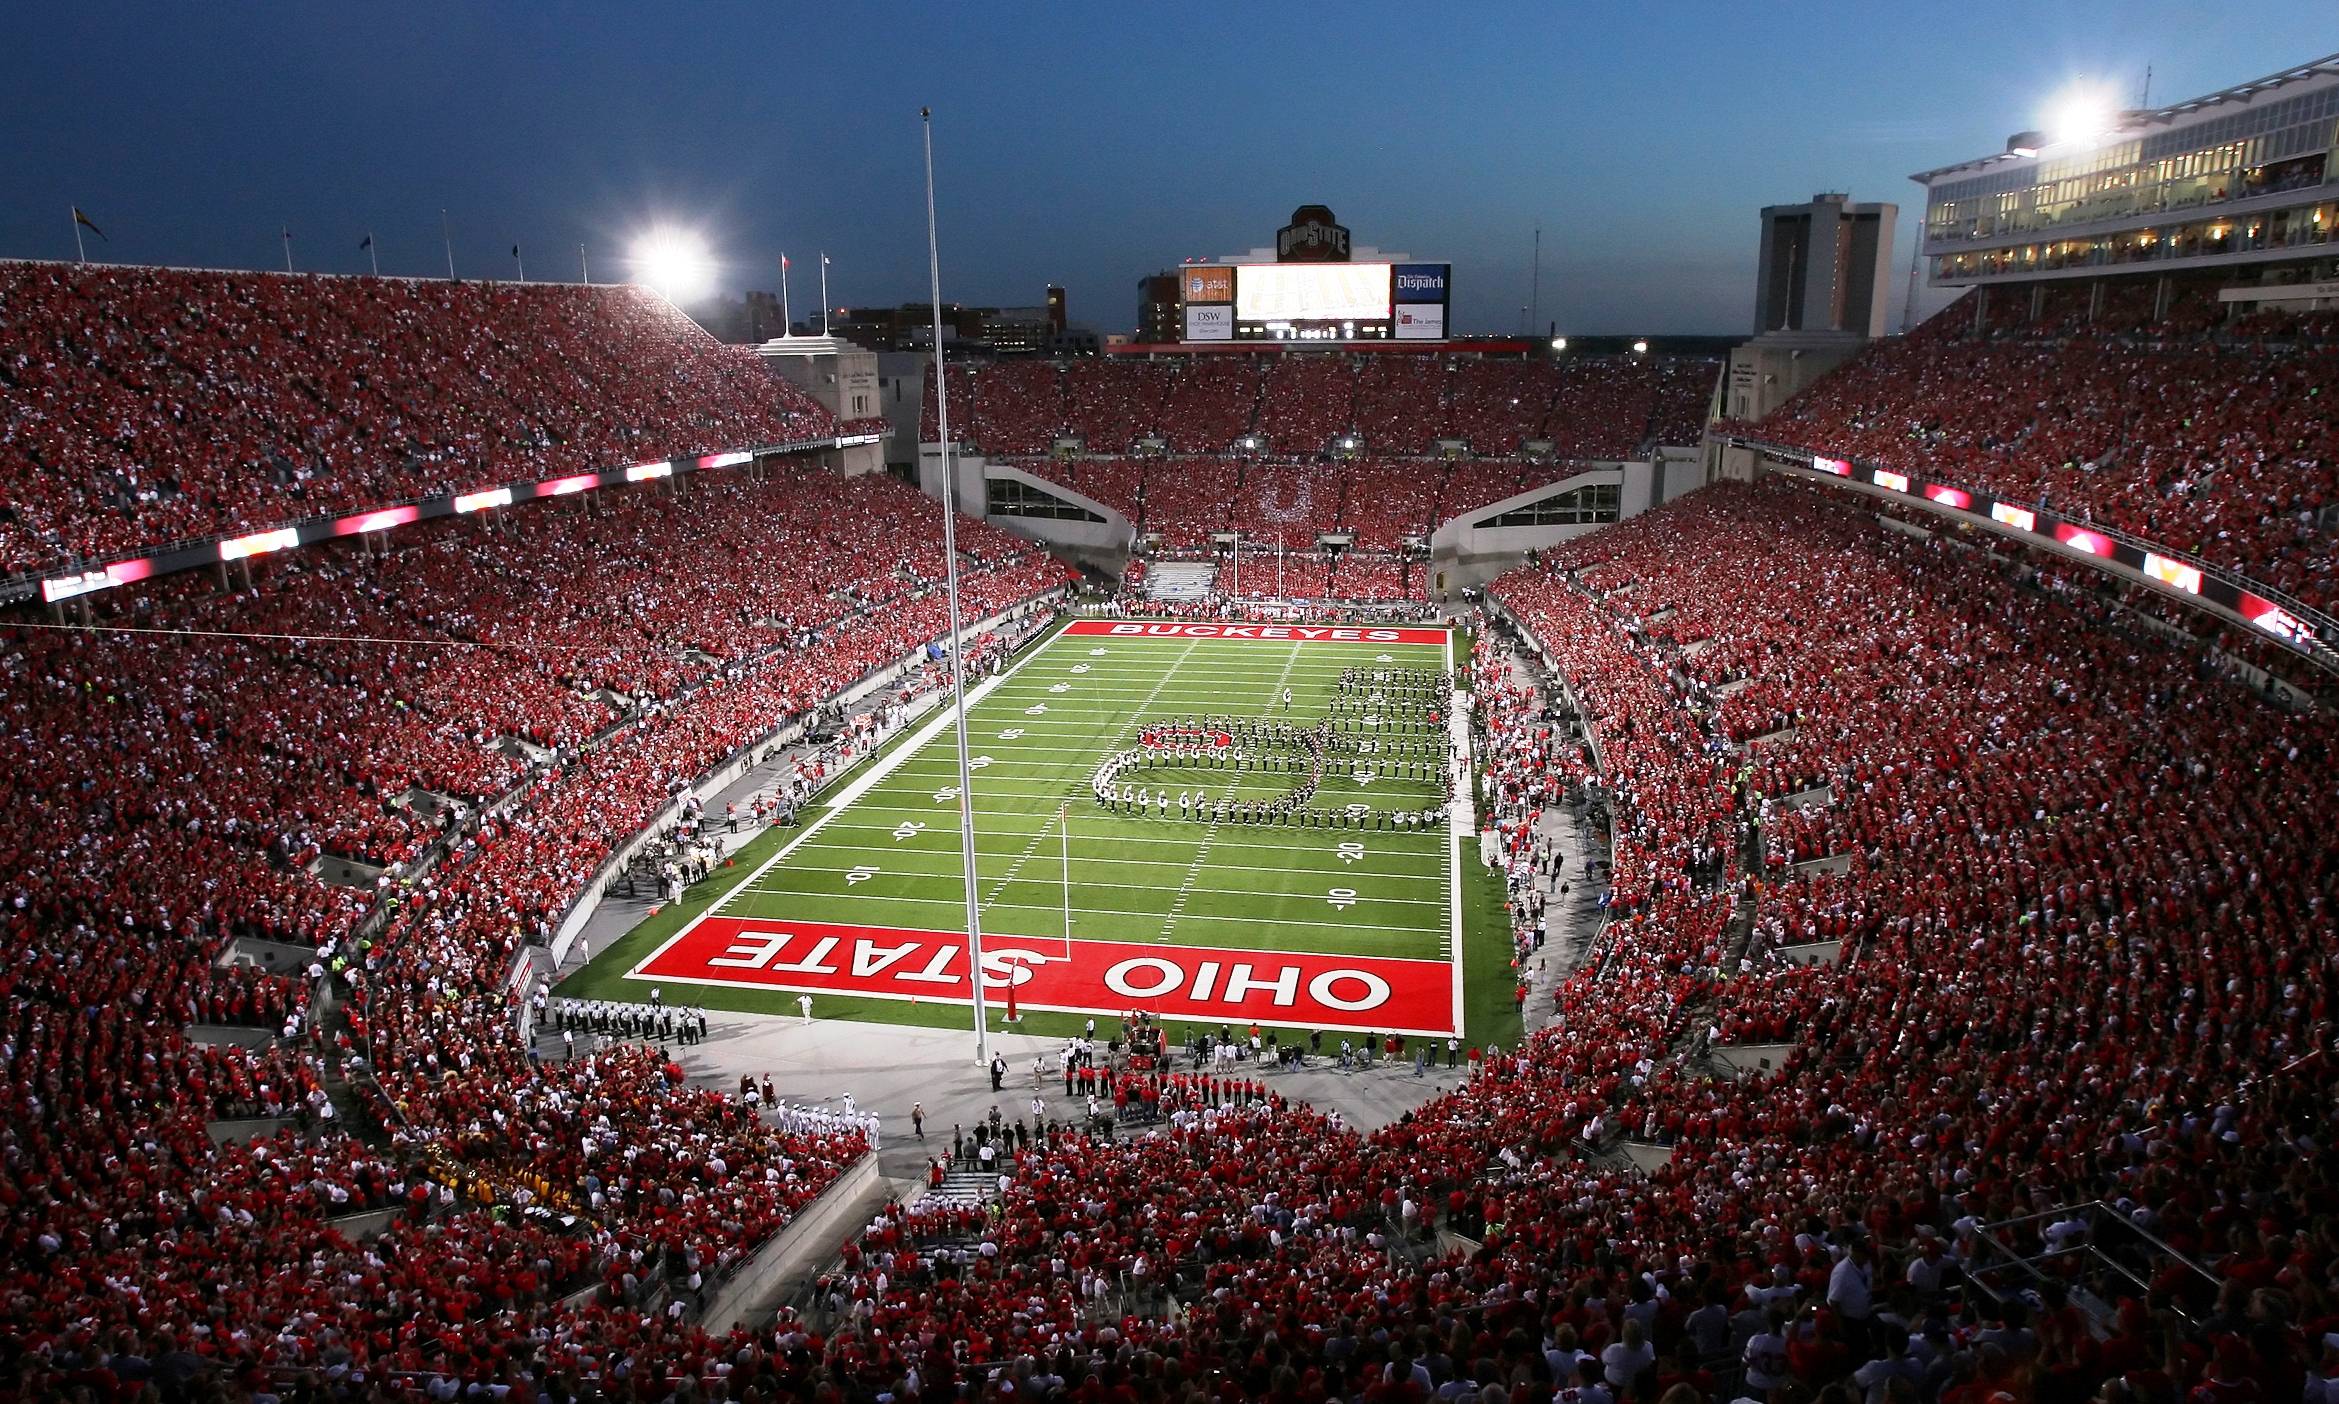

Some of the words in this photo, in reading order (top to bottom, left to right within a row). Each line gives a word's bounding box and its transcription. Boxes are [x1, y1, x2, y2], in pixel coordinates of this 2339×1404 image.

[1397, 275, 1444, 291] Dispatch
[1197, 312, 1221, 321] DSW
[1110, 623, 1400, 641] BUCKEYES
[998, 728, 1025, 740] 50
[932, 785, 962, 800] 30
[892, 821, 926, 837] 20
[1336, 842, 1364, 860] 20
[845, 865, 881, 881] 10
[1326, 887, 1357, 905] 10
[707, 930, 1048, 988] STATE
[1103, 956, 1392, 1012] OHIO
